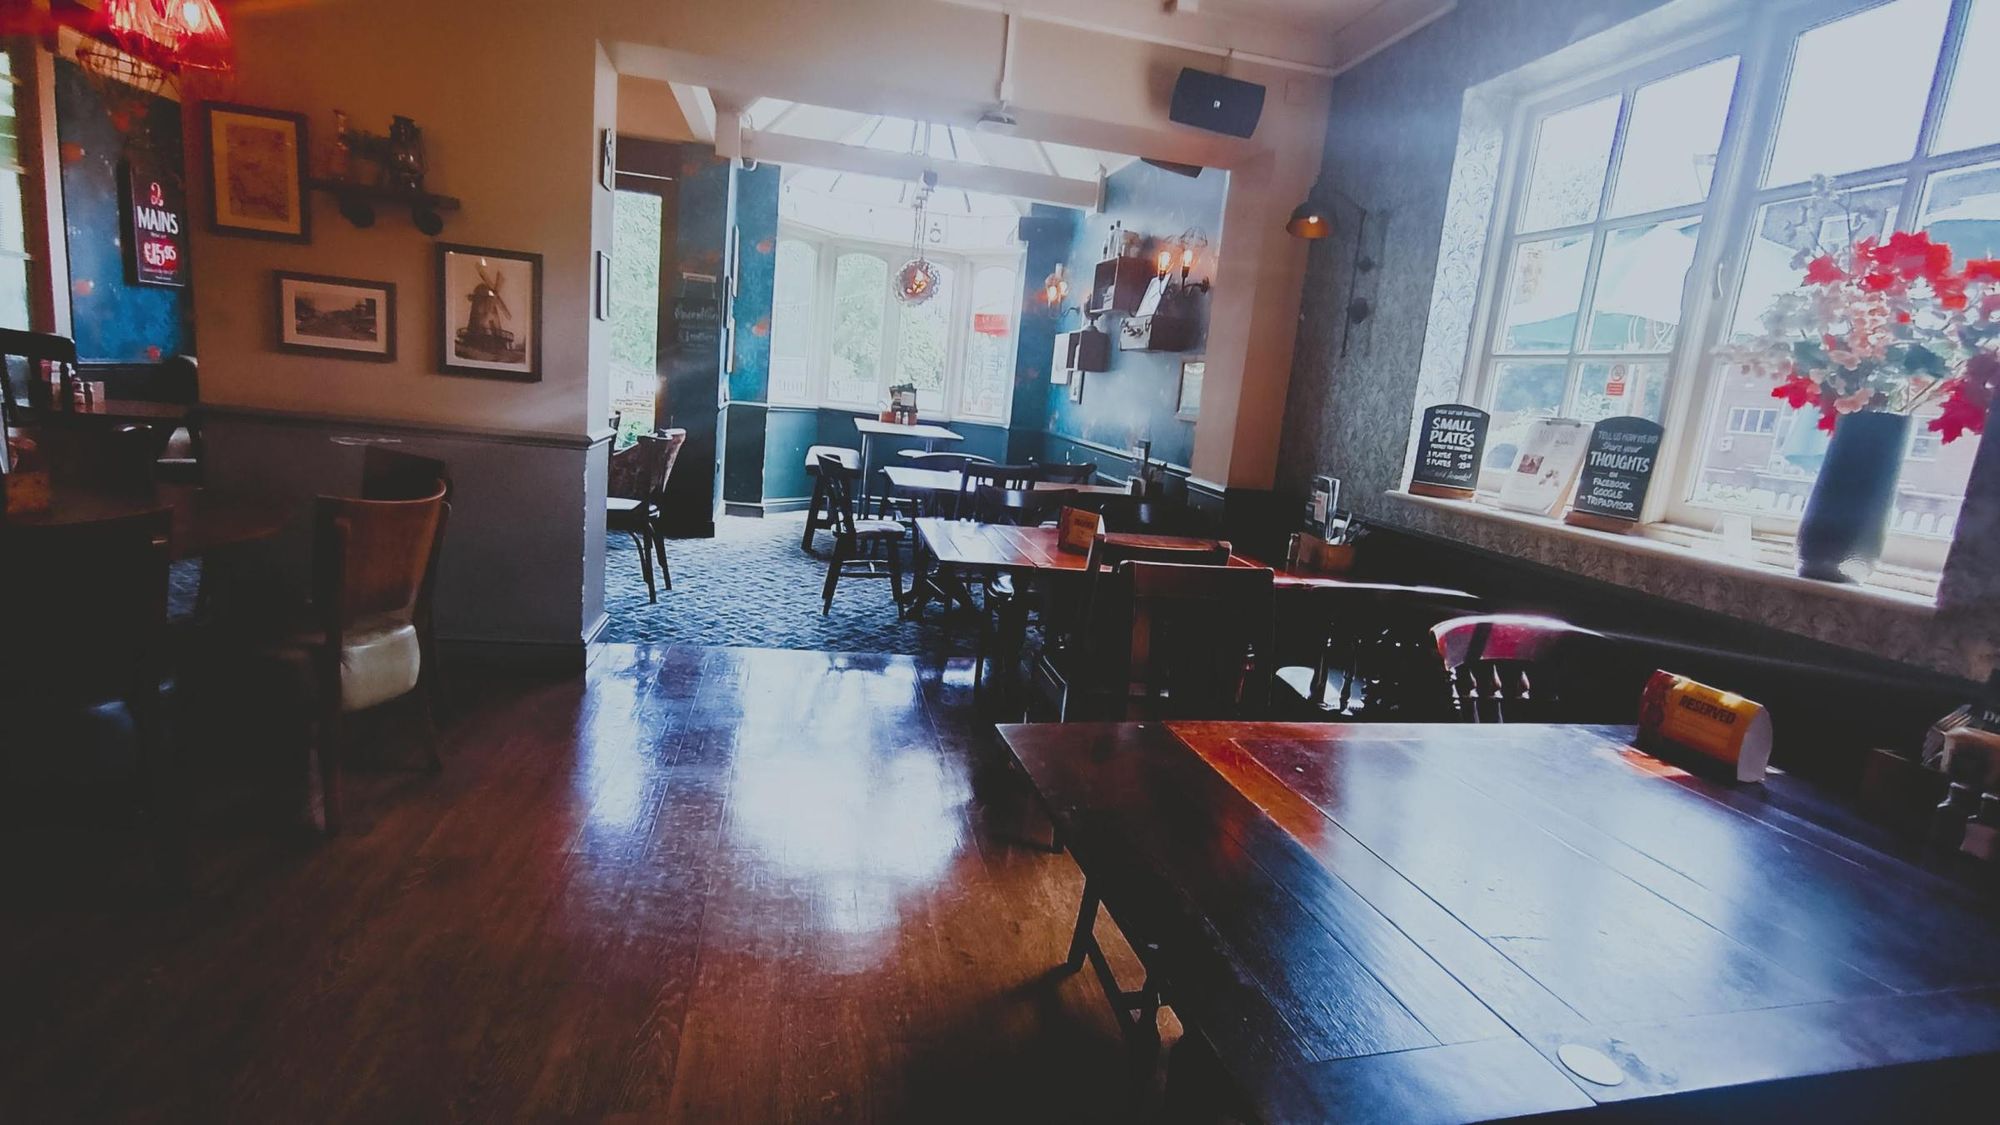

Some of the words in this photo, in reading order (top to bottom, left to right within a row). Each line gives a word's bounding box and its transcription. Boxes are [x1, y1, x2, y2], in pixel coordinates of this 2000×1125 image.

[150, 182, 164, 207] 2
[136, 205, 179, 235] MAINS
[1431, 417, 1475, 433] SMALL
[1429, 430, 1475, 448] PLATES
[1589, 451, 1651, 473] THOUGHTS
[1593, 477, 1631, 490] FACEBOOK
[1593, 486, 1624, 499] GOOGLE
[1586, 495, 1635, 512] TRIPADVISOR
[1679, 694, 1737, 725] RESERVED
